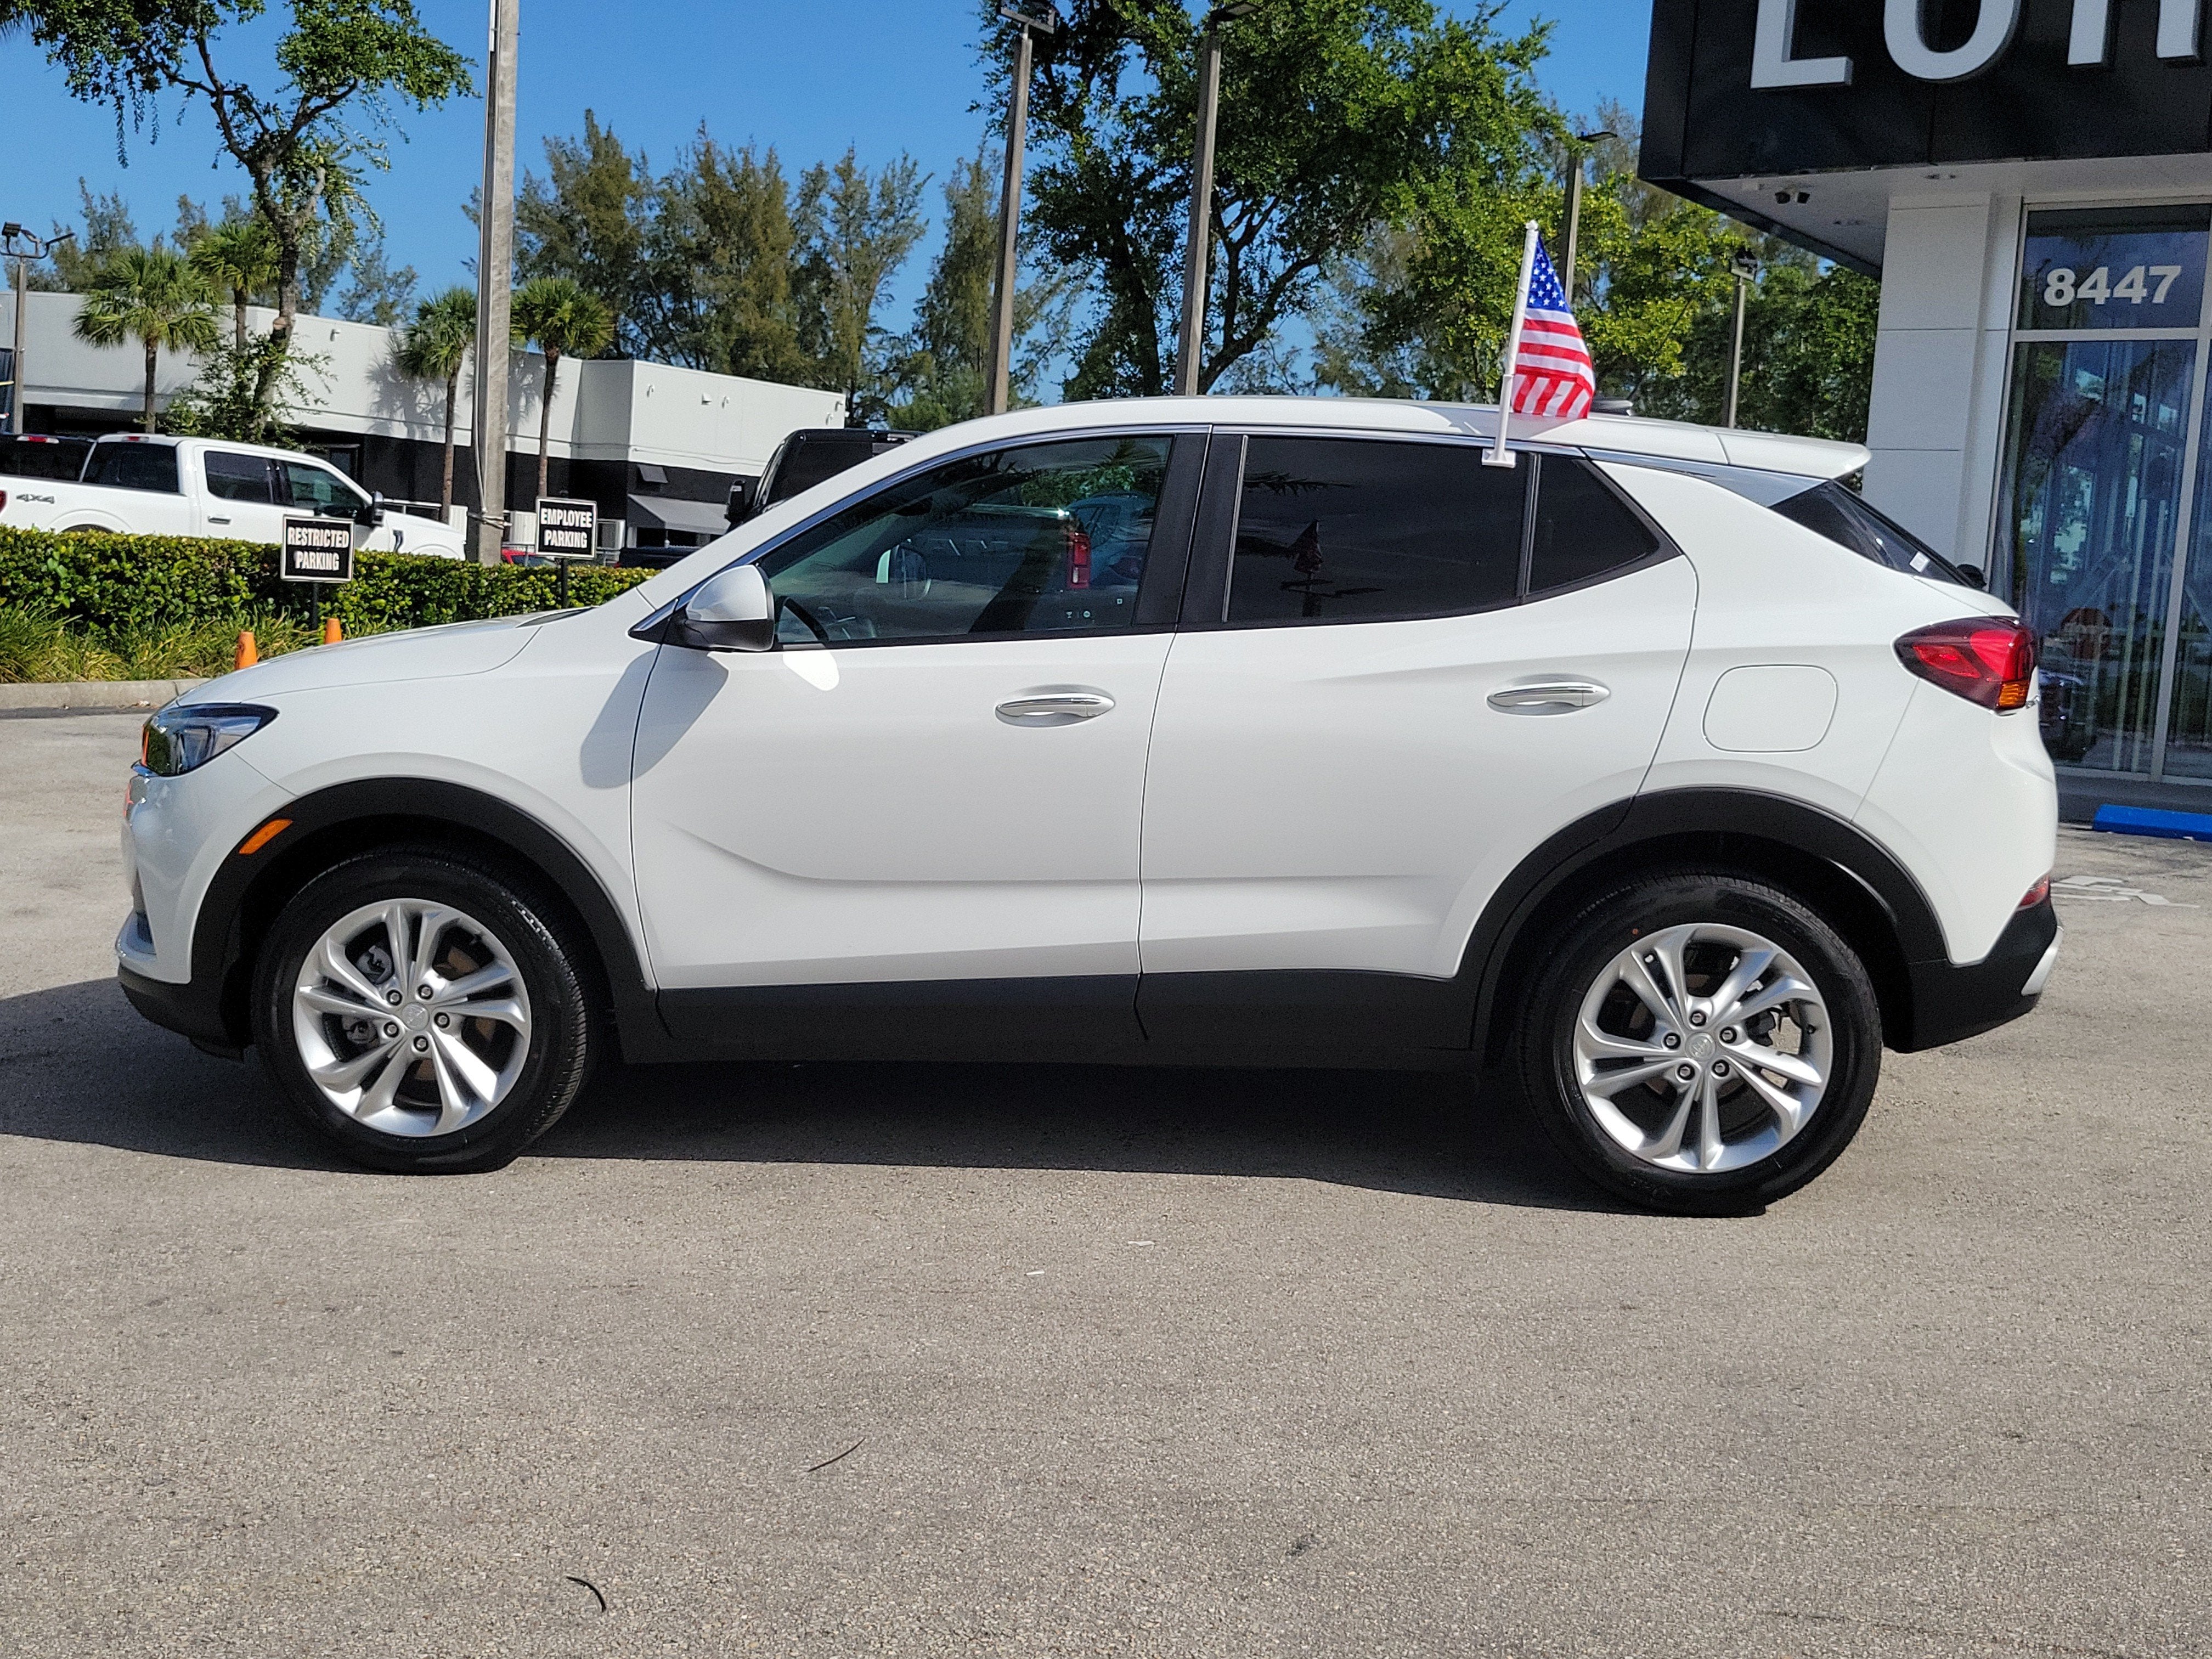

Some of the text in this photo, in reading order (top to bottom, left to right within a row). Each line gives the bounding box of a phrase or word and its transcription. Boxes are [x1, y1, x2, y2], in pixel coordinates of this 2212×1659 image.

[2044, 265, 2181, 306] 8447
[540, 507, 592, 528] EMPLOYEE
[287, 526, 349, 548] RESTRICTED
[544, 529, 588, 549] PARKING
[294, 550, 340, 571] PARKING
